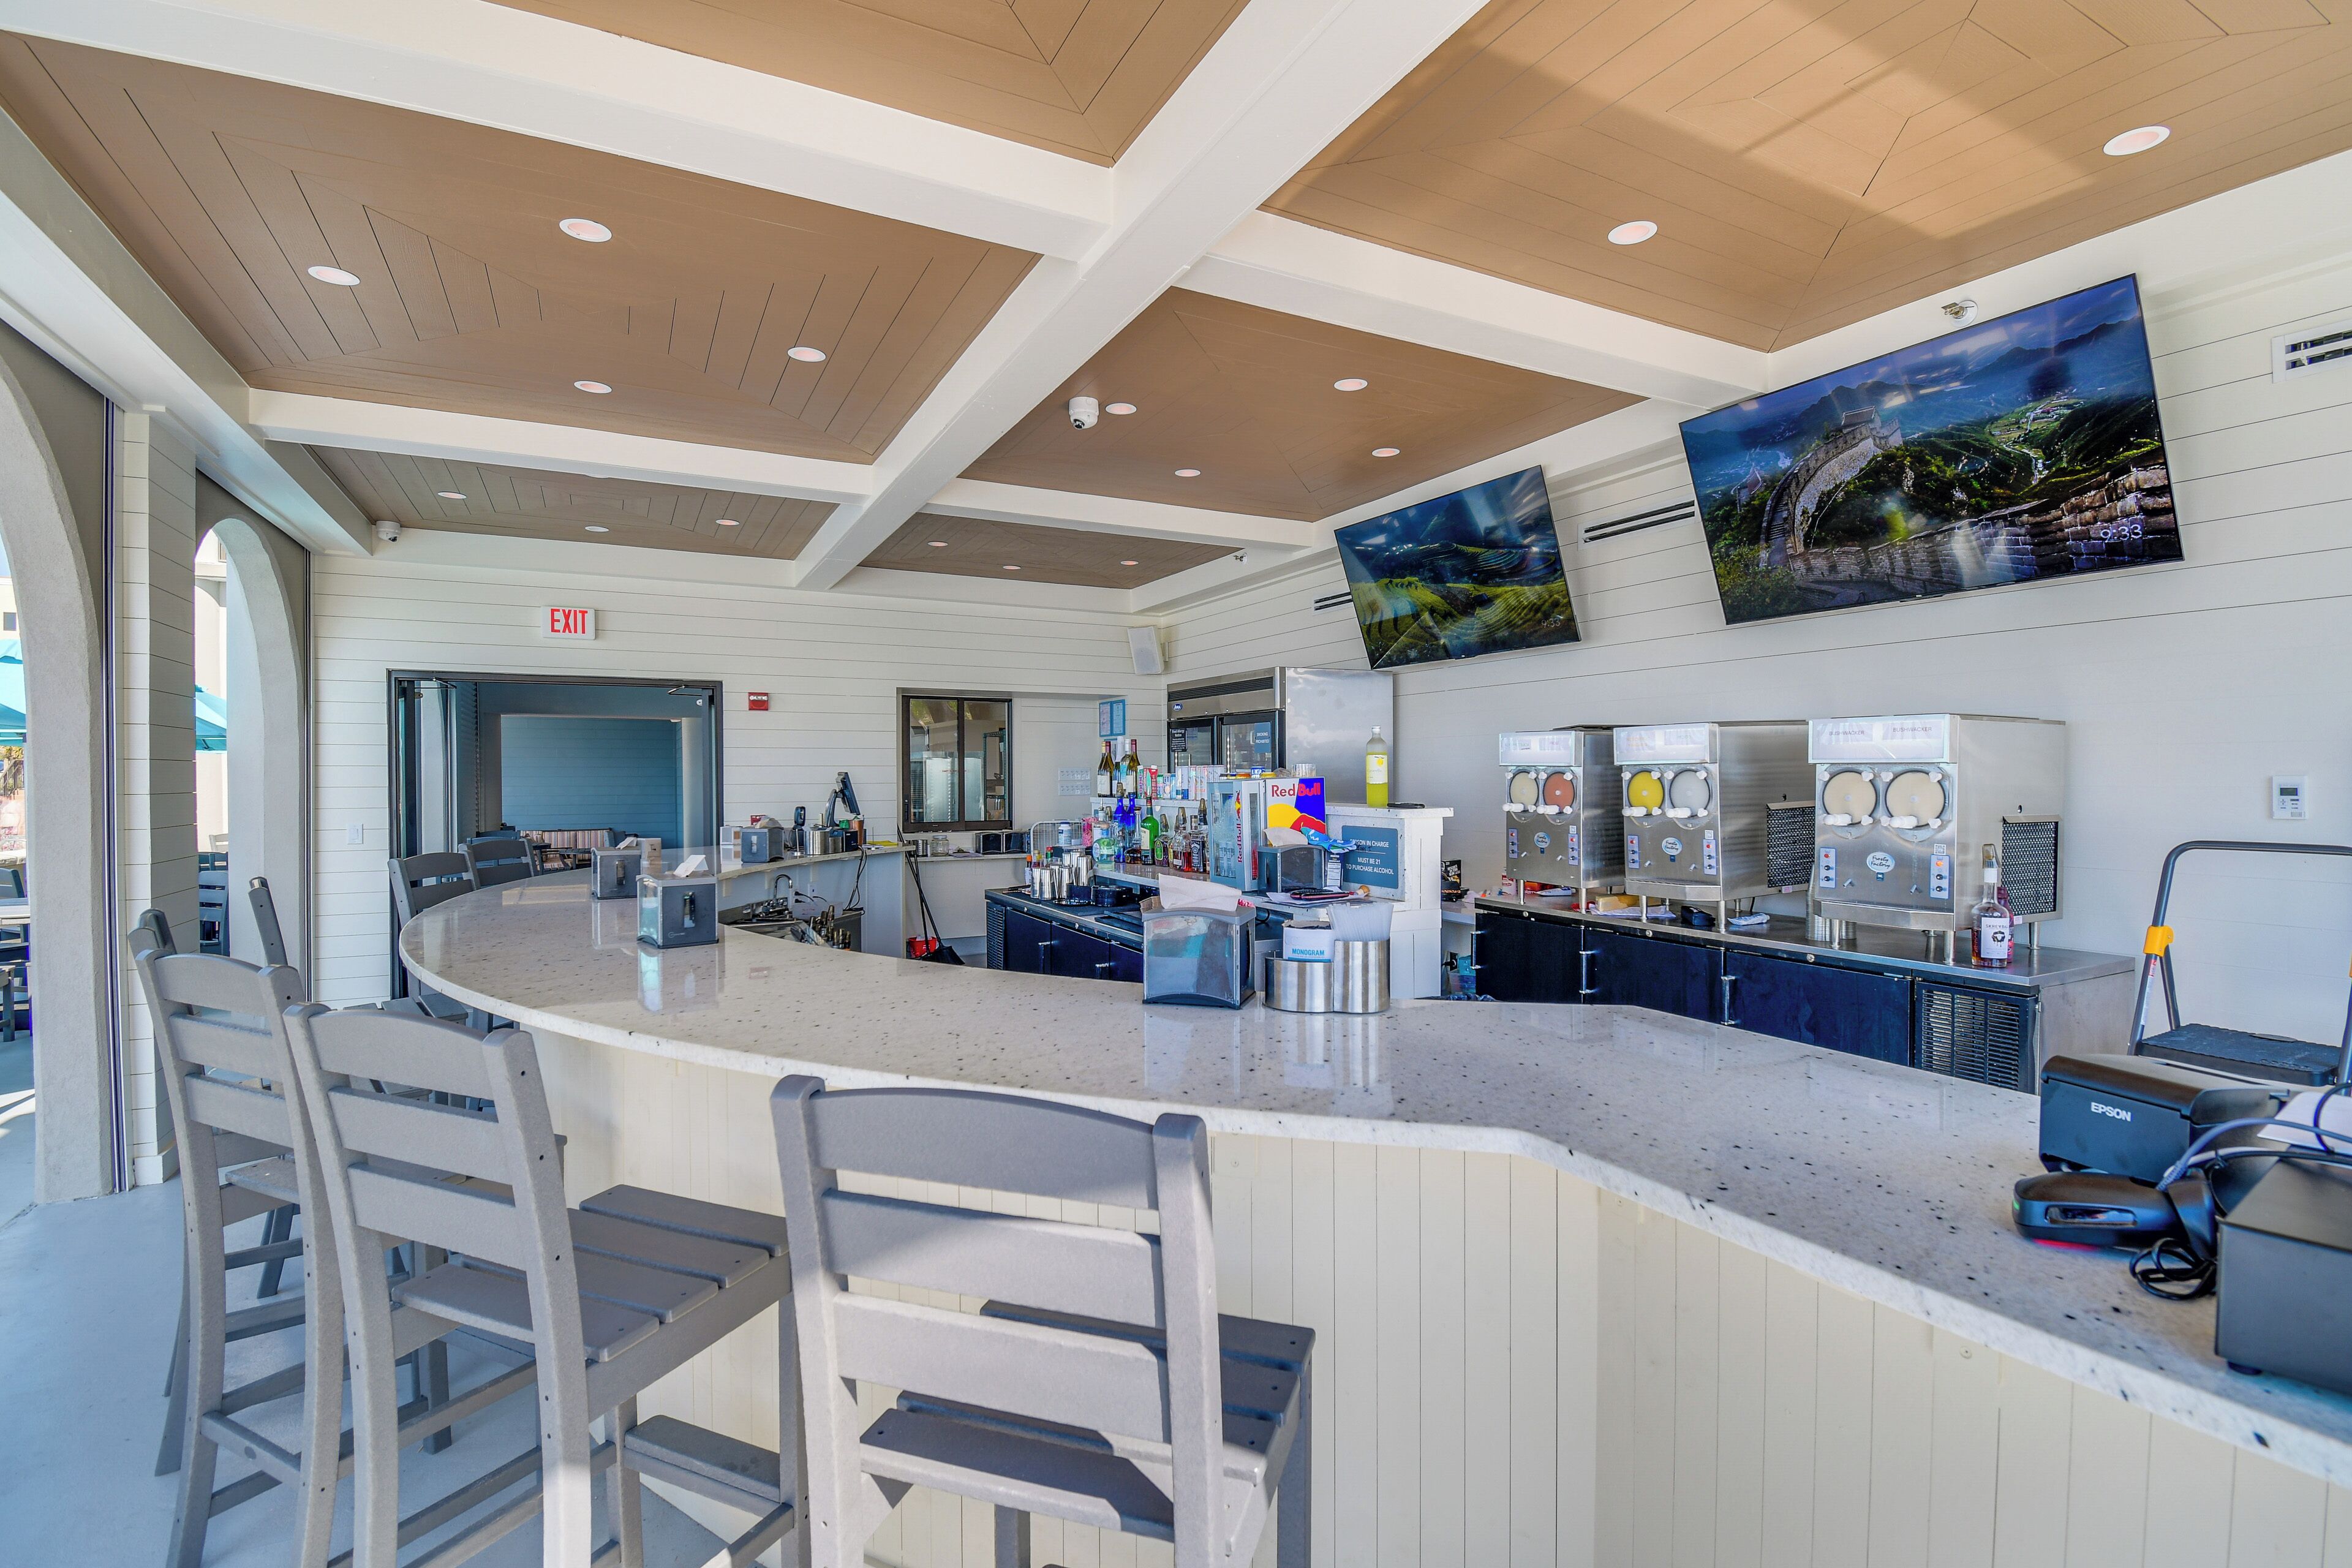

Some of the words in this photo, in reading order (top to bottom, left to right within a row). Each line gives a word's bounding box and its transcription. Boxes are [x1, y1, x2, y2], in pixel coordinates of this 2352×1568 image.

[2100, 524, 2142, 543] 9:33
[551, 608, 588, 634] EXIT
[1541, 617, 1561, 628] 9:33
[1271, 783, 1296, 797] Red
[1297, 782, 1321, 796] Bull
[1871, 860, 1890, 869] Factory
[2090, 1101, 2132, 1122] EPSON
